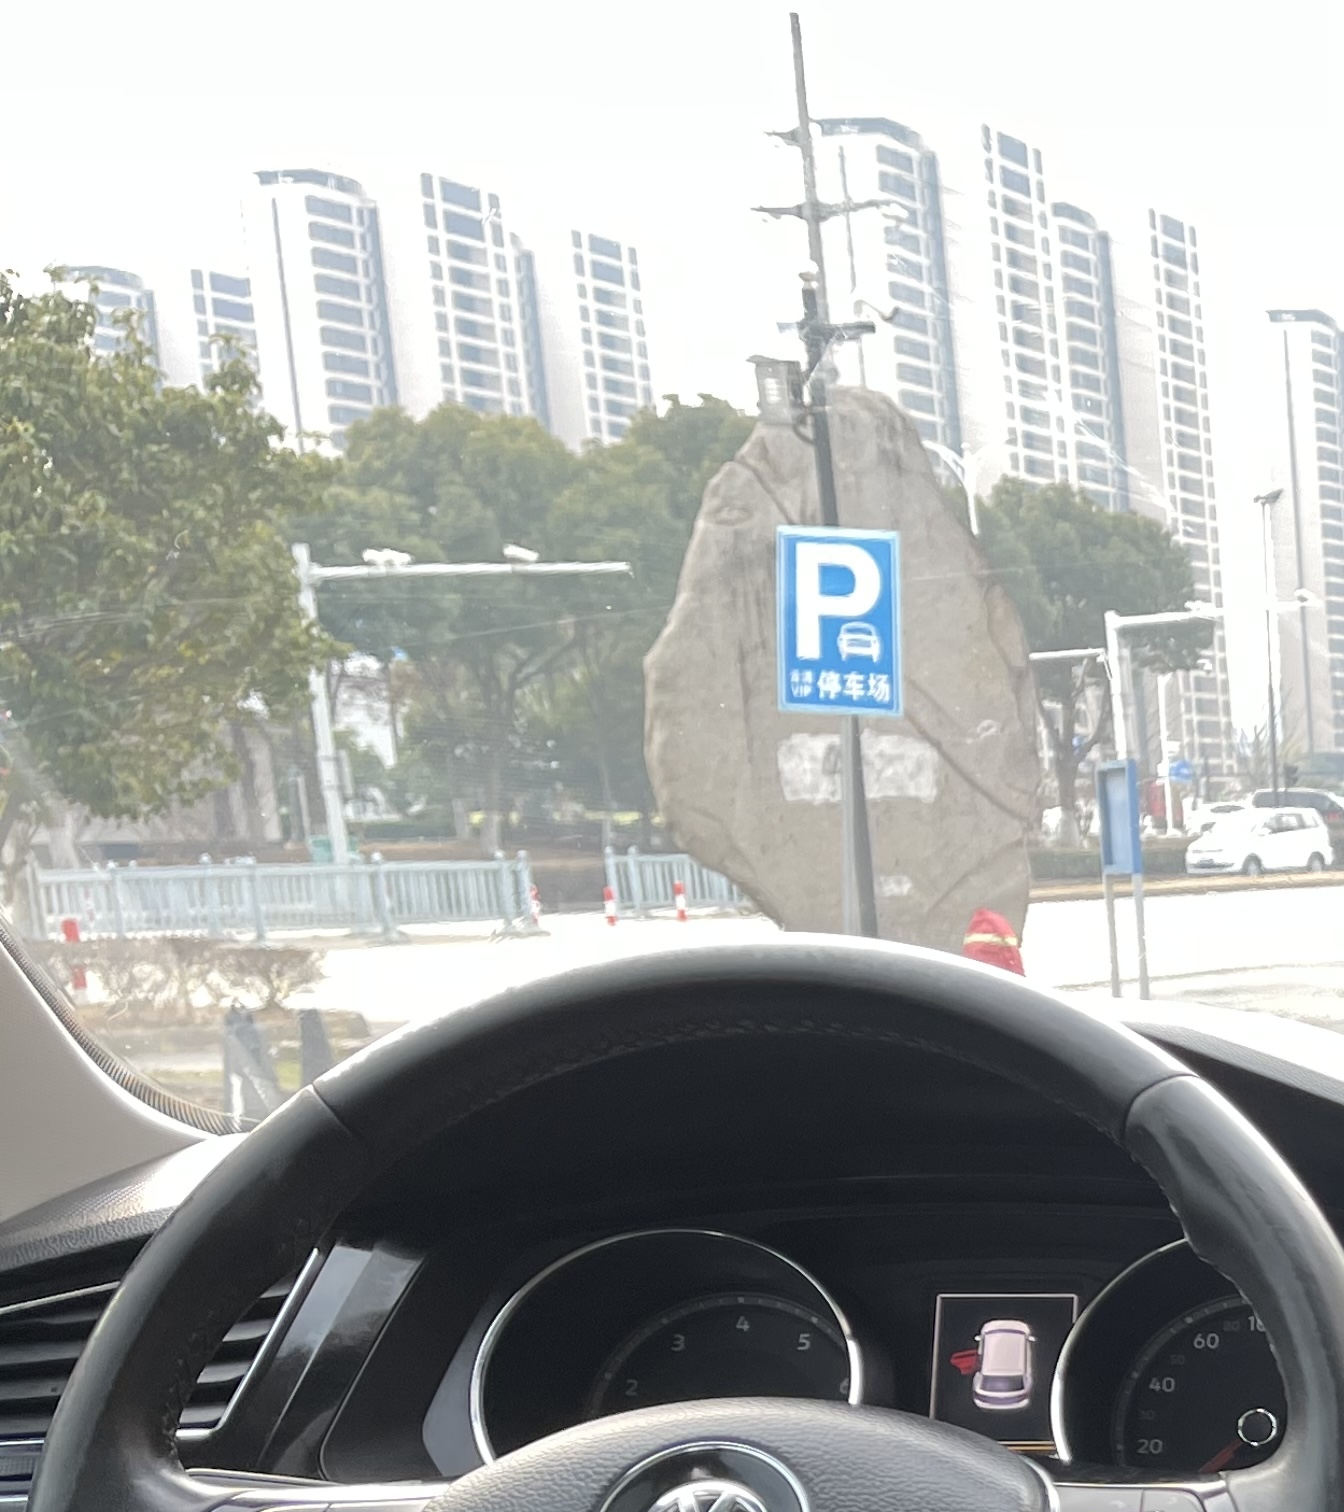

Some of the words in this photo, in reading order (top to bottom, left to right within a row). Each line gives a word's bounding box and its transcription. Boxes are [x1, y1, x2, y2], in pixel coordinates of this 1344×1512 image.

[795, 541, 881, 660] P
[817, 669, 891, 703] 停车场
[736, 1316, 750, 1332] 4
[671, 1335, 685, 1351] 3
[797, 1333, 811, 1350] 5
[1193, 1333, 1219, 1349] 60
[625, 1379, 639, 1396] 2
[1149, 1377, 1175, 1392] 40
[1137, 1439, 1163, 1454] 20
